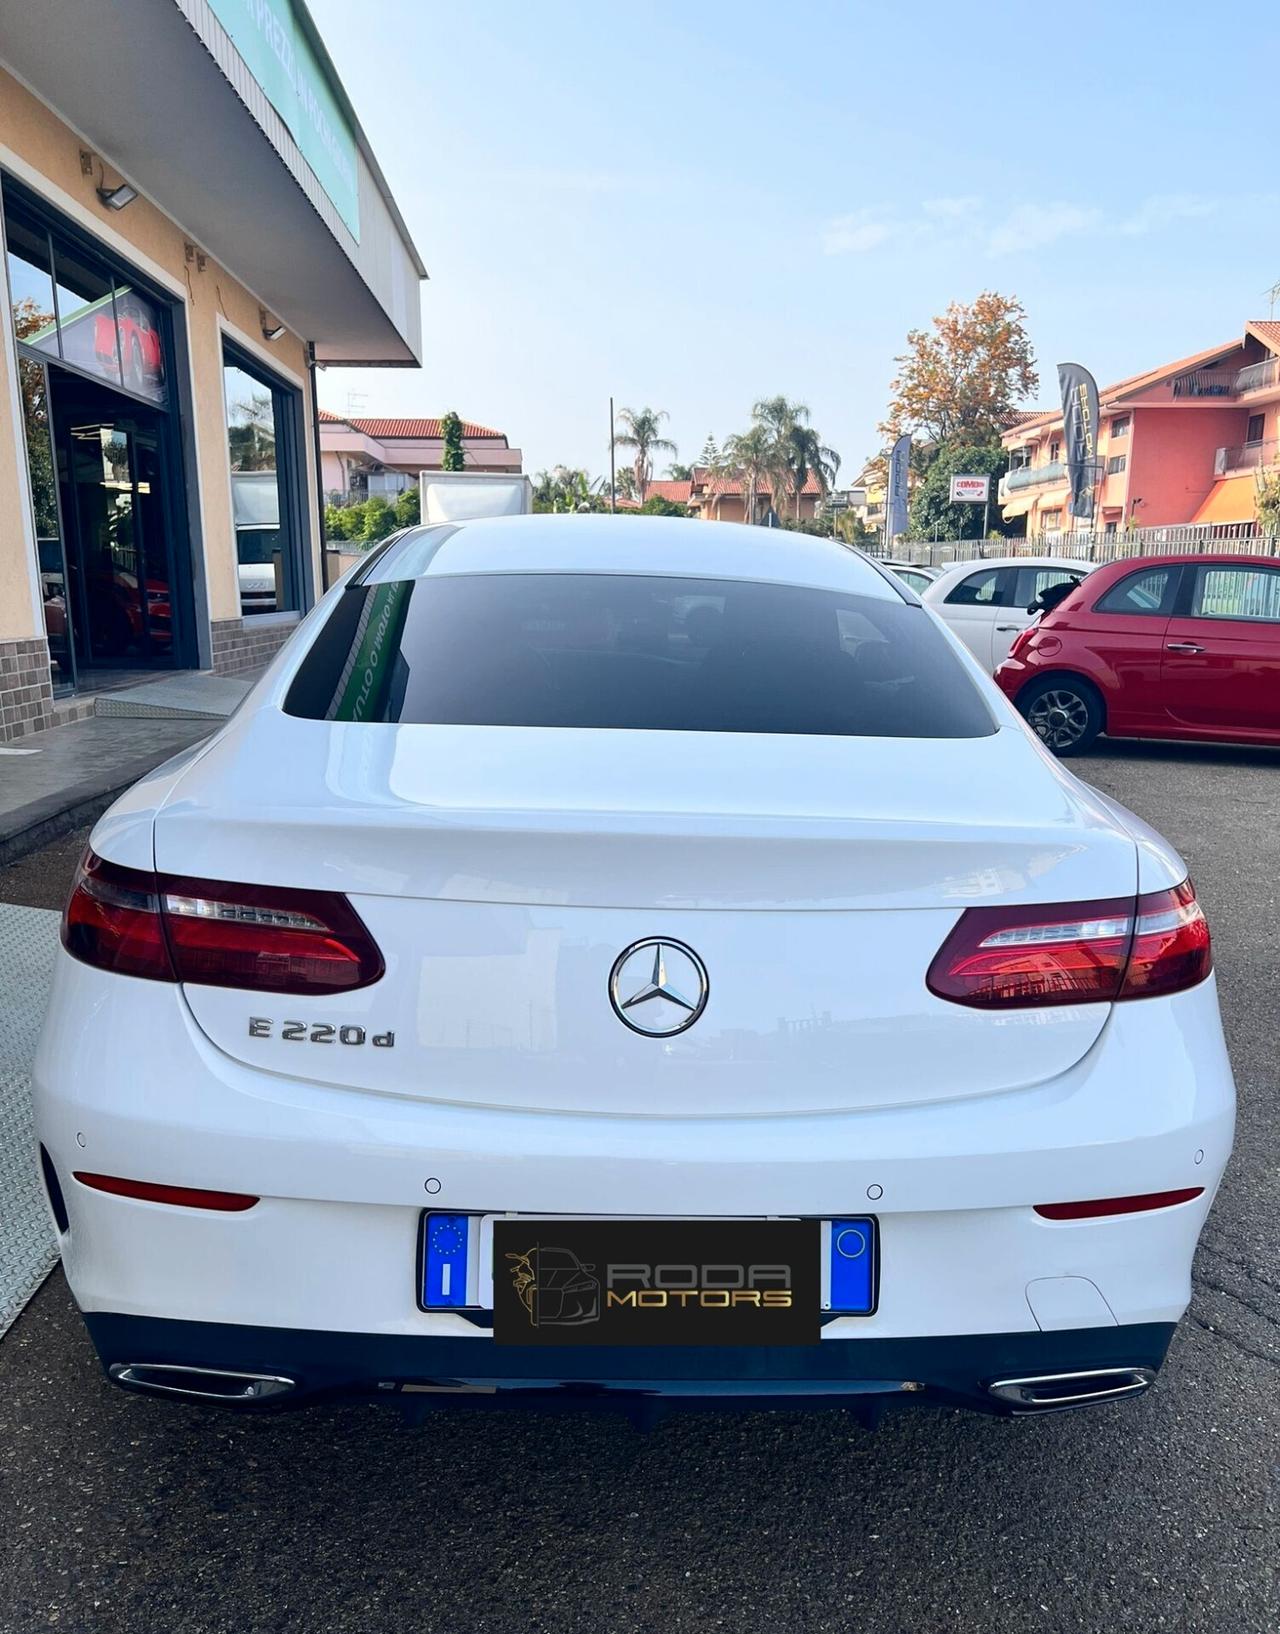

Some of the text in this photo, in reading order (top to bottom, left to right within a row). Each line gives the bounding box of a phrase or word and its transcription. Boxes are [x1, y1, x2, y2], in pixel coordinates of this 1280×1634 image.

[1079, 383, 1094, 459] MOTORS
[249, 1016, 273, 1038] E
[281, 1018, 367, 1045] 220
[442, 1263, 451, 1296] I
